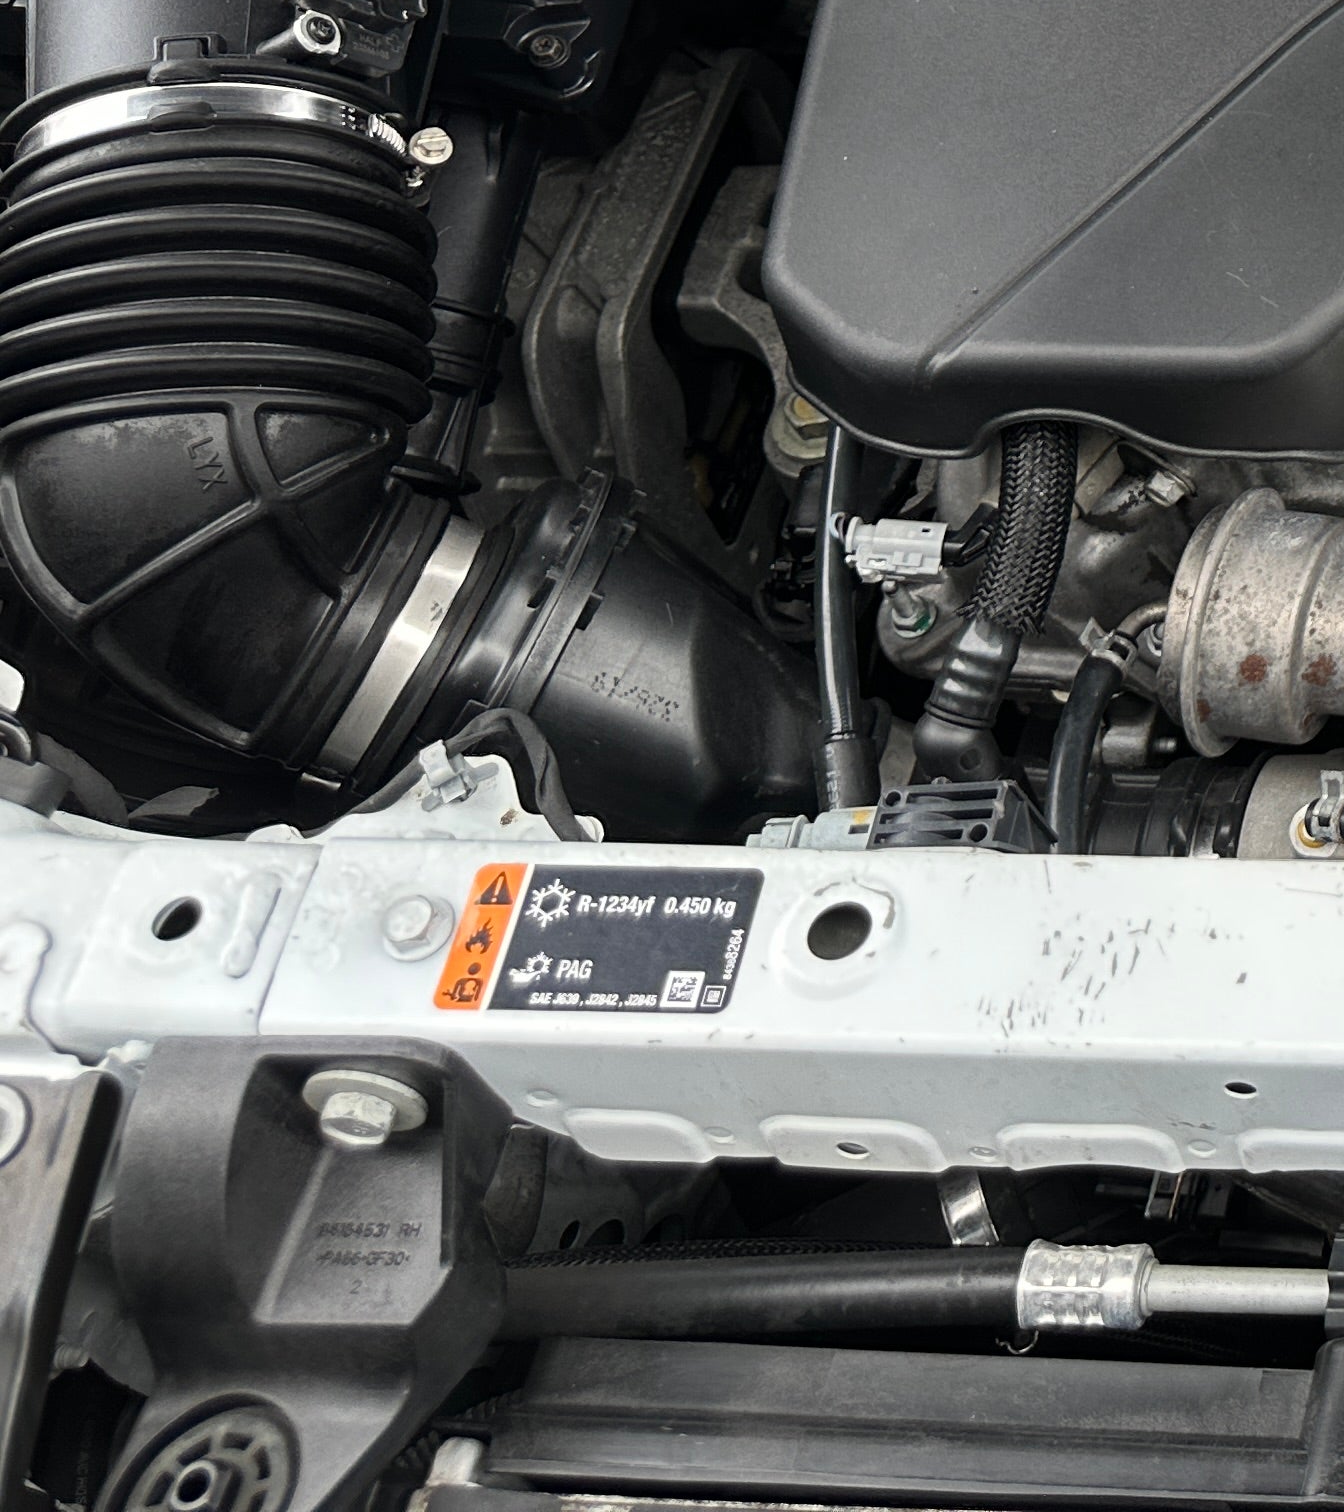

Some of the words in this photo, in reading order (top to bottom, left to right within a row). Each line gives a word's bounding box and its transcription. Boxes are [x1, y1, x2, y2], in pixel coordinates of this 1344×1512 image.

[576, 895, 655, 917] R-1234yf
[664, 895, 711, 916] 0.450
[713, 897, 737, 919] kg
[556, 959, 593, 980] PAG
[529, 992, 553, 1005] SAE
